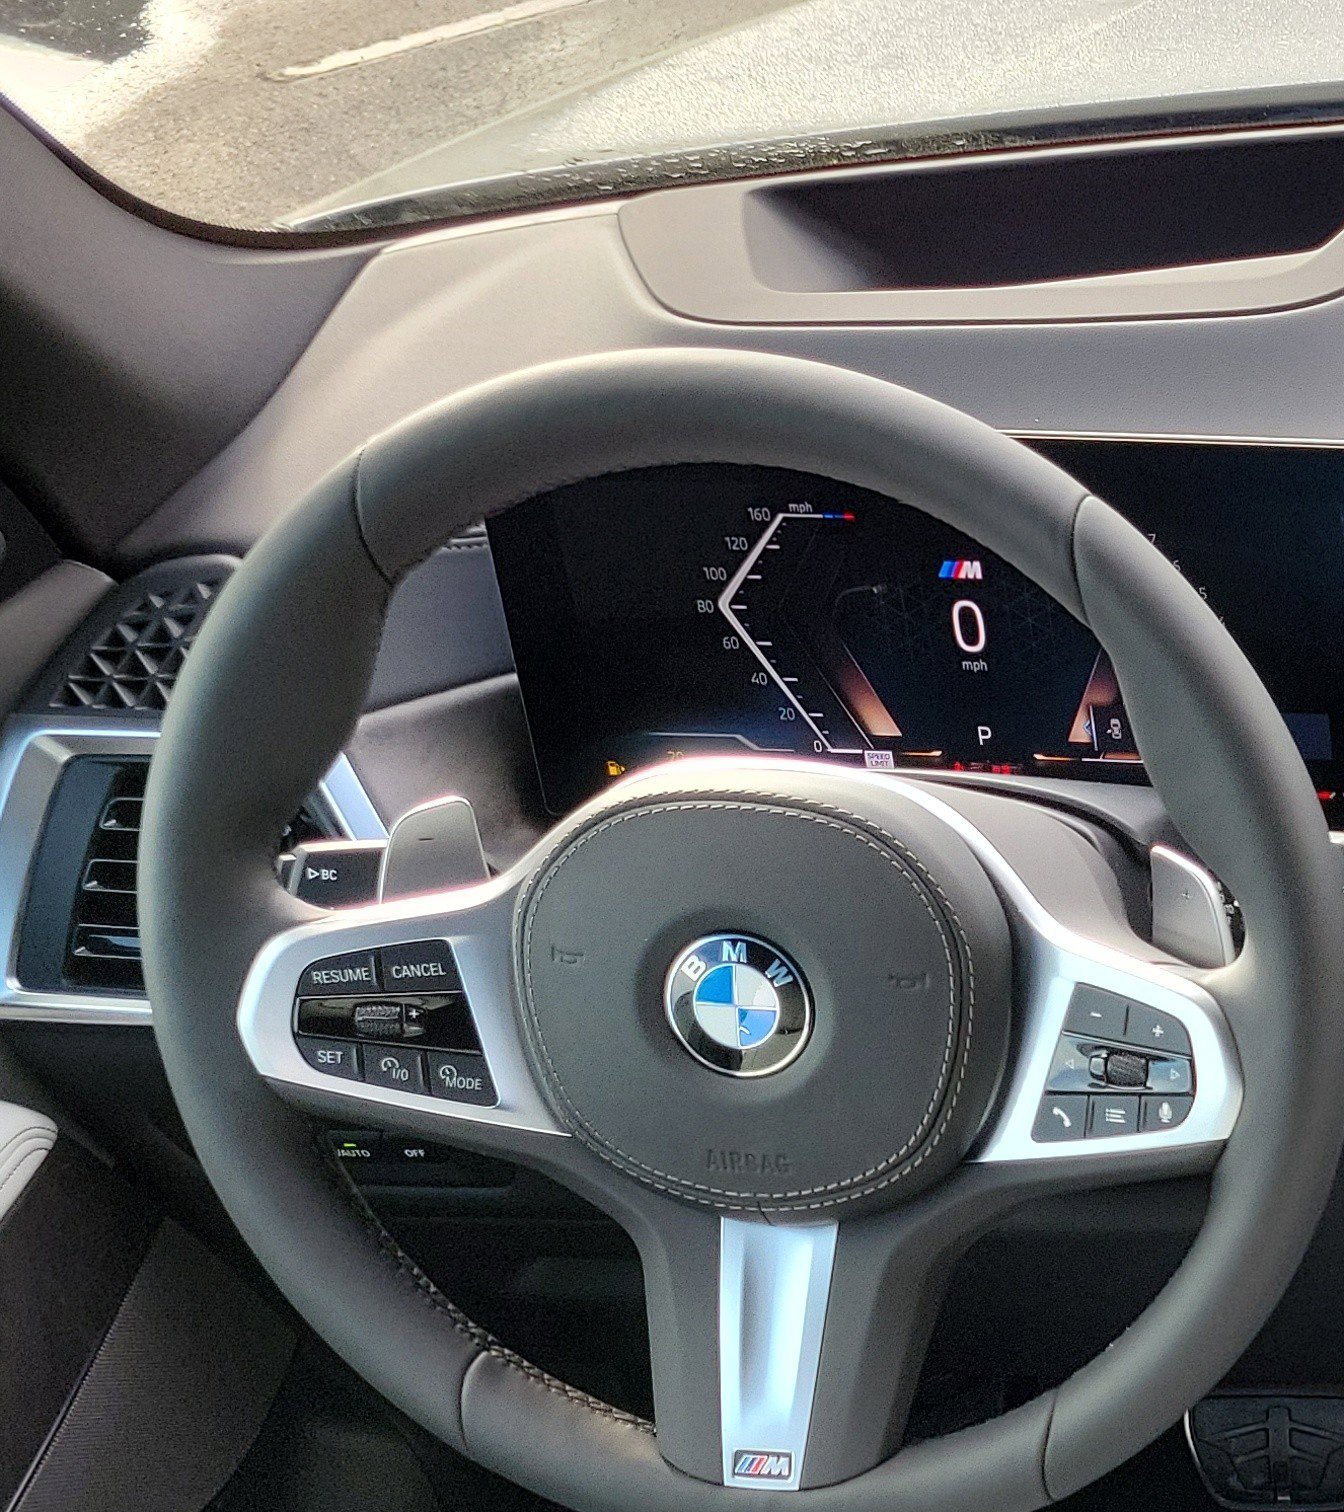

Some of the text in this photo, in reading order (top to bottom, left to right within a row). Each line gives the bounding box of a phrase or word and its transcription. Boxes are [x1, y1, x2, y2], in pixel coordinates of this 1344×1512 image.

[747, 507, 771, 523] 160
[789, 502, 812, 514] mph
[725, 537, 748, 551] 120
[703, 567, 726, 581] 100
[697, 600, 714, 614] 80
[952, 599, 987, 653] 0
[723, 636, 740, 650] 60
[962, 660, 988, 673] mph
[751, 672, 768, 686] 40
[779, 707, 795, 721] 20
[977, 726, 992, 745] P
[813, 740, 822, 754] 0
[322, 869, 338, 881] BC
[392, 963, 446, 979] CANCEL
[681, 942, 793, 988] BMW
[313, 967, 371, 984] RESUME
[318, 1050, 343, 1064] SET
[445, 1077, 482, 1091] MODE
[404, 1149, 424, 1157] OFF
[706, 1149, 791, 1174] AIRBAG
